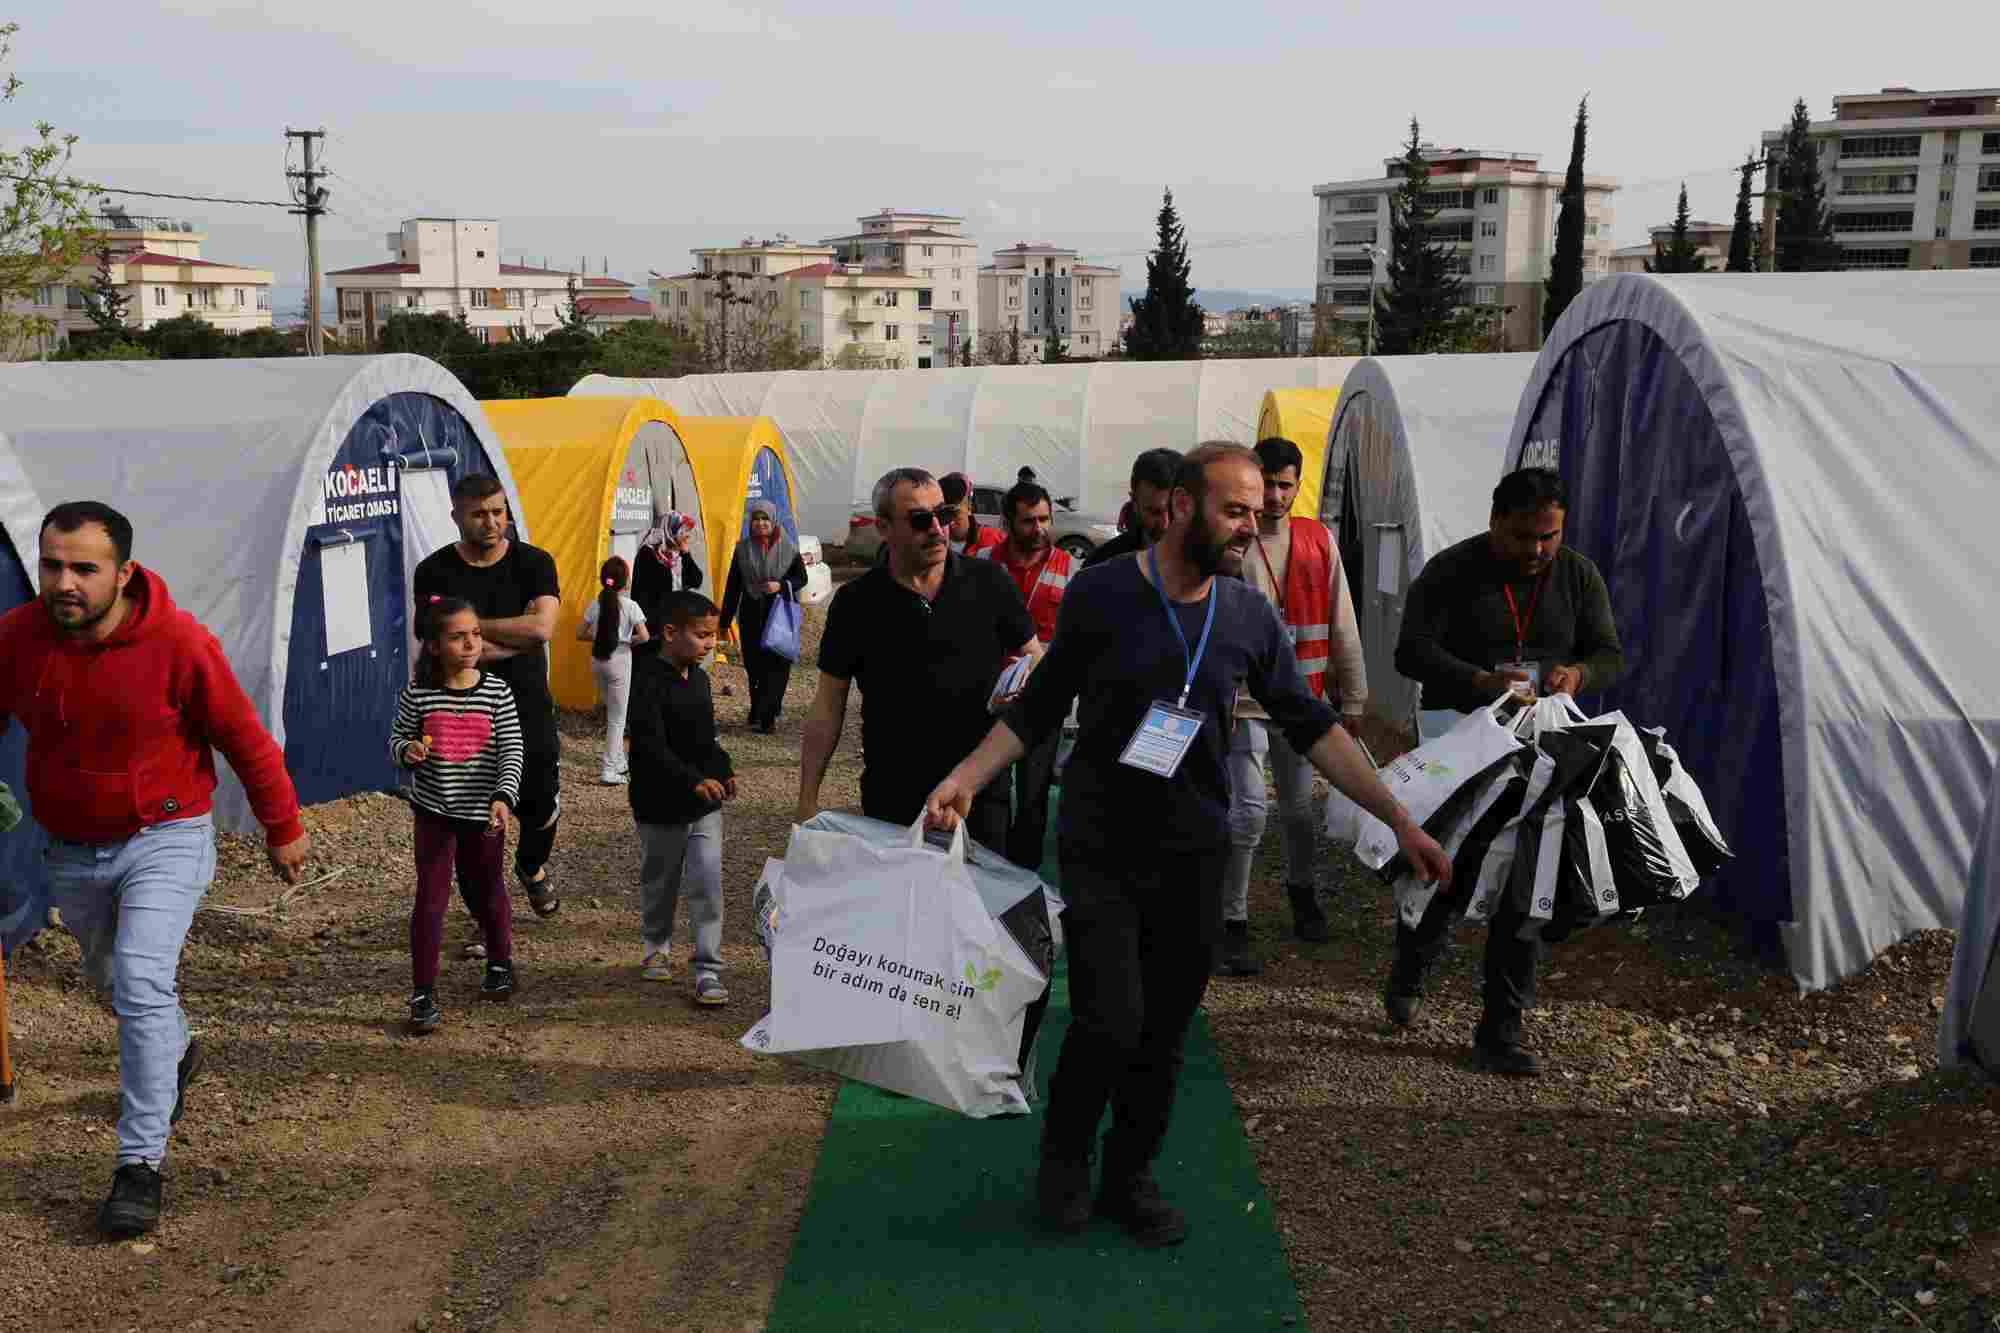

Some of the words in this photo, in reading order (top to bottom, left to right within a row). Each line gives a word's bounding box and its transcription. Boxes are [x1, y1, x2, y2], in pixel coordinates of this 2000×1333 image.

[327, 502, 366, 523] TİCARET
[812, 936, 873, 968] Doğayı
[812, 961, 838, 981] bir
[840, 972, 884, 995] adım
[888, 984, 908, 1002] da
[912, 993, 940, 1013] sen
